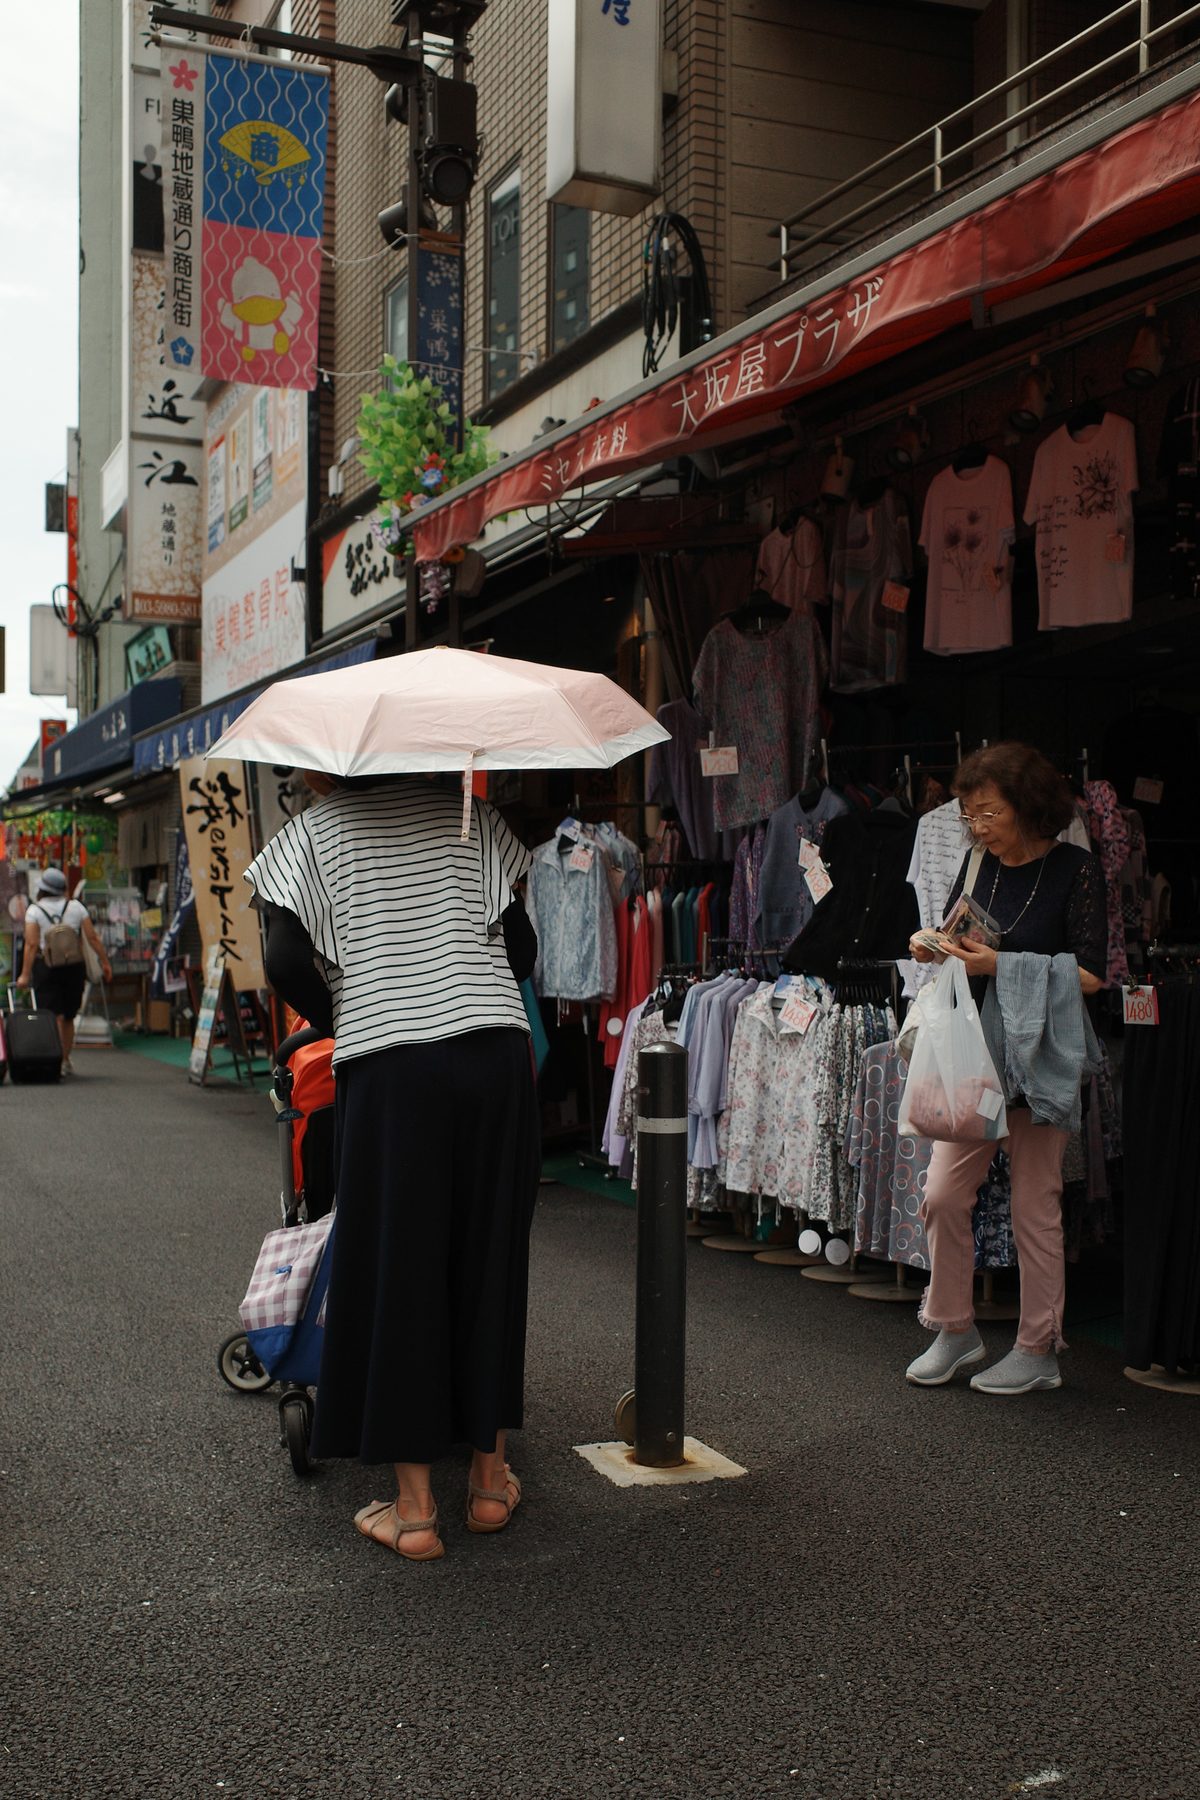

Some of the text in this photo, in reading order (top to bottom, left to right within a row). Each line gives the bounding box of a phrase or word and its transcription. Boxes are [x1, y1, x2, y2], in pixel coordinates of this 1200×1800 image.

[250, 132, 279, 166] 商
[171, 97, 194, 328] 巣鴨地蔵通り商店街
[427, 309, 450, 386] 巣鴨地
[672, 277, 883, 439] 大坂屋プラザ
[161, 502, 176, 566] 地蔵通り
[782, 1003, 808, 1028] 1480
[1125, 1000, 1153, 1021] 1480
